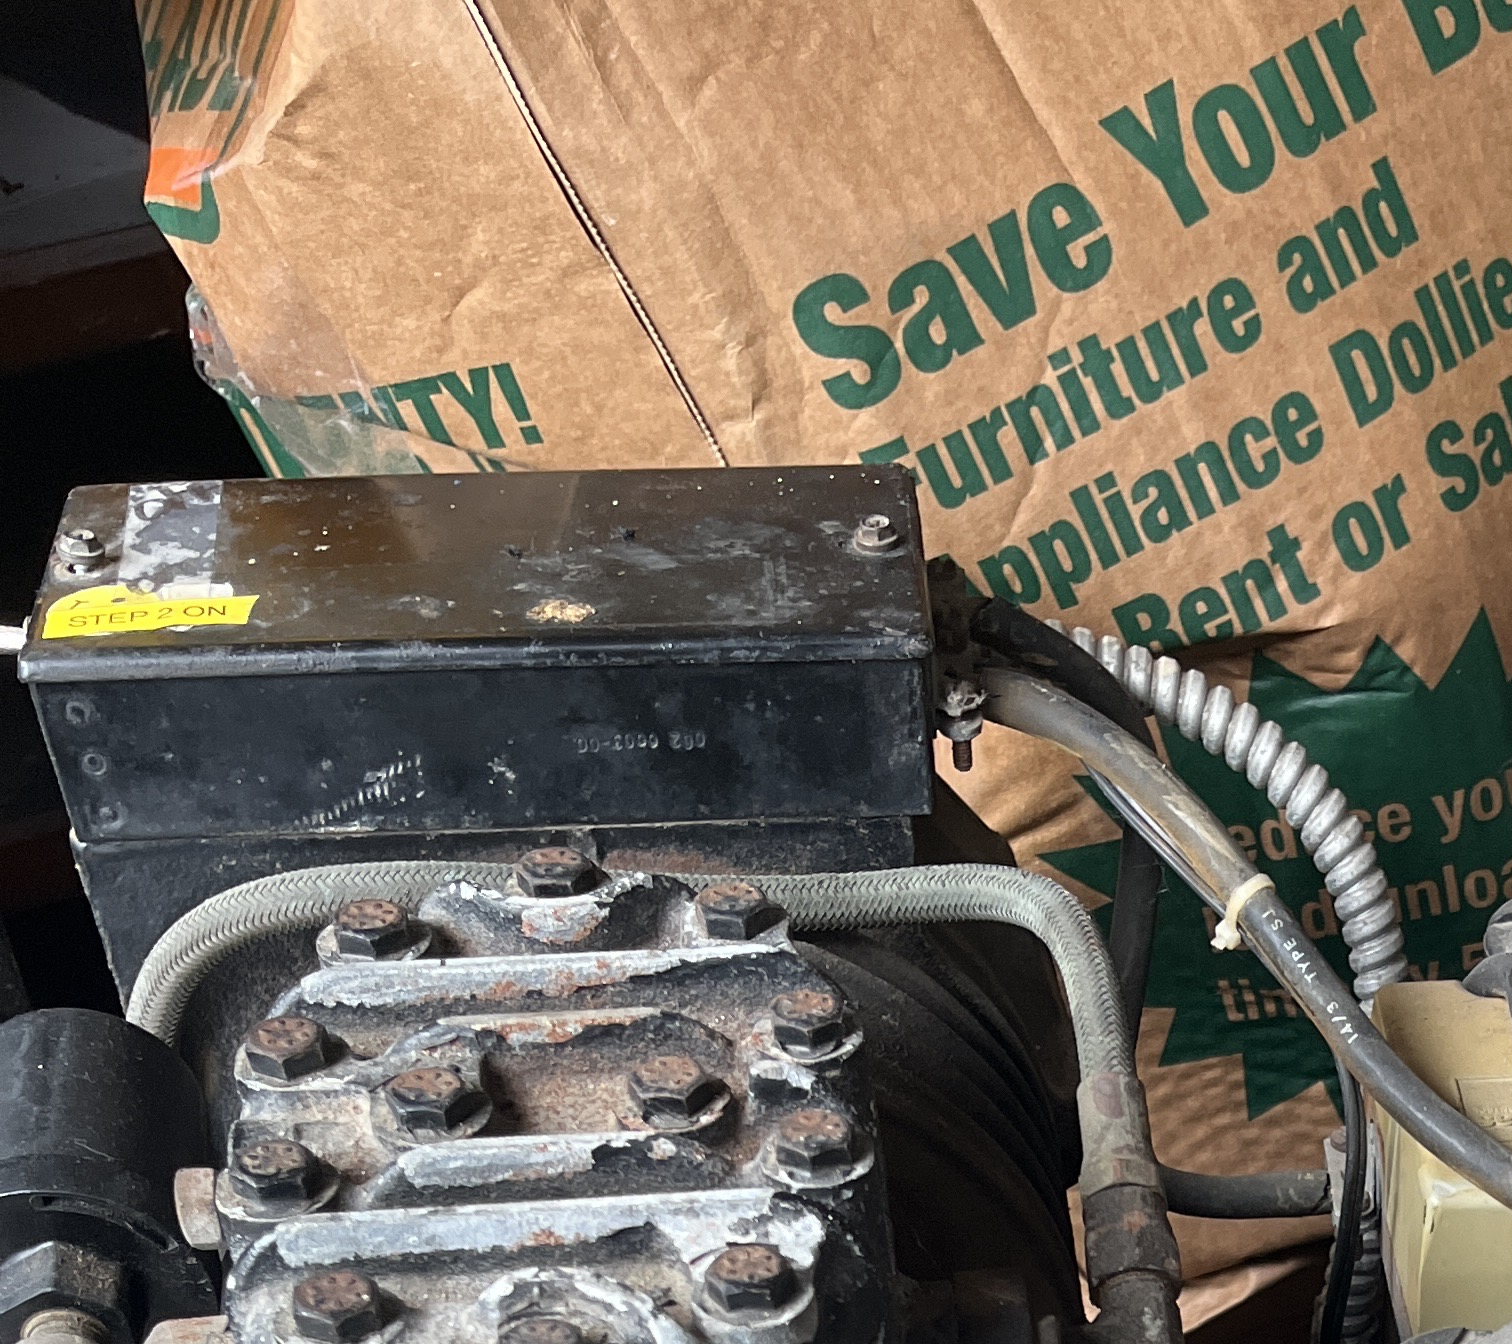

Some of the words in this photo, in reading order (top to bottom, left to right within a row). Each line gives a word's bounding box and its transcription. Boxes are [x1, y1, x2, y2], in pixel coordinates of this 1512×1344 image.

[792, 182, 1113, 410] Save
[1098, 6, 1377, 228] Your
[1276, 155, 1418, 315] and
[940, 389, 1326, 609] ppliance
[1111, 525, 1320, 648] Rent
[1331, 473, 1413, 575] or
[68, 610, 148, 628] STEP
[158, 607, 172, 620] 2
[183, 605, 226, 618] ON
[1283, 937, 1317, 984] TYPE
[1326, 1001, 1359, 1044] 14/3
